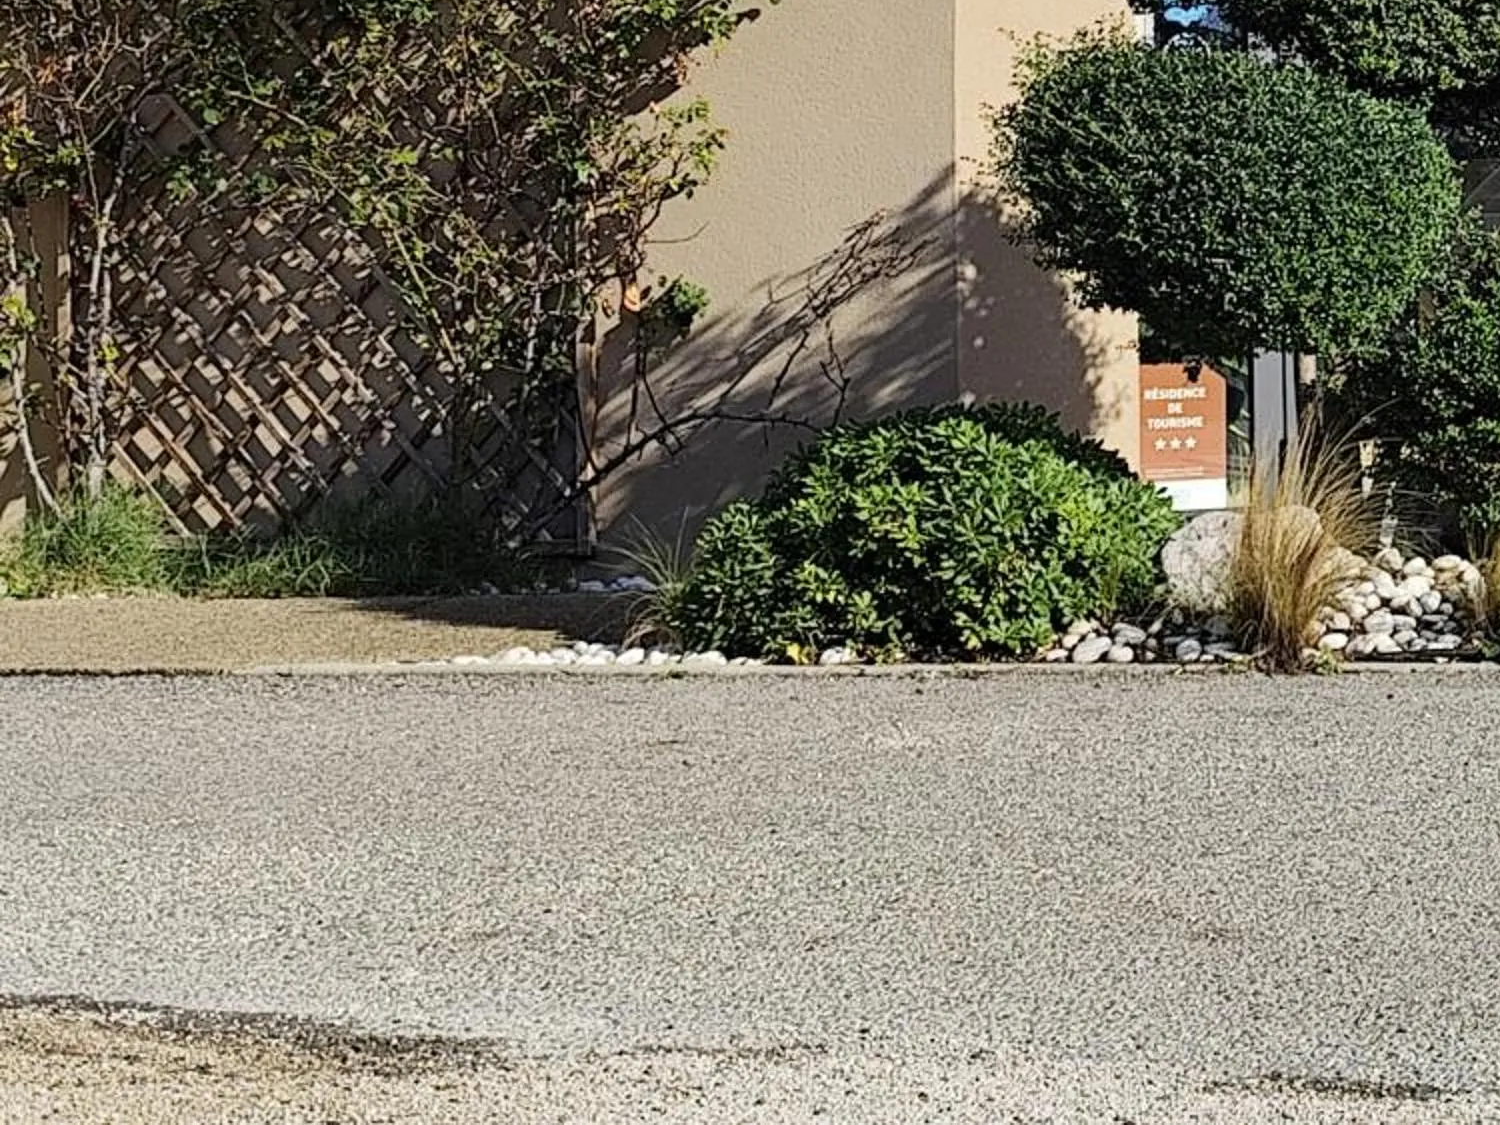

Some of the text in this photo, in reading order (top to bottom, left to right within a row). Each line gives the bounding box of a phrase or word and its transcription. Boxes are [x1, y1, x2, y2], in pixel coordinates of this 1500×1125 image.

[1143, 386, 1207, 400] RÉSIDENCE
[1167, 402, 1183, 414] DE
[1148, 416, 1204, 430] TOURISME
